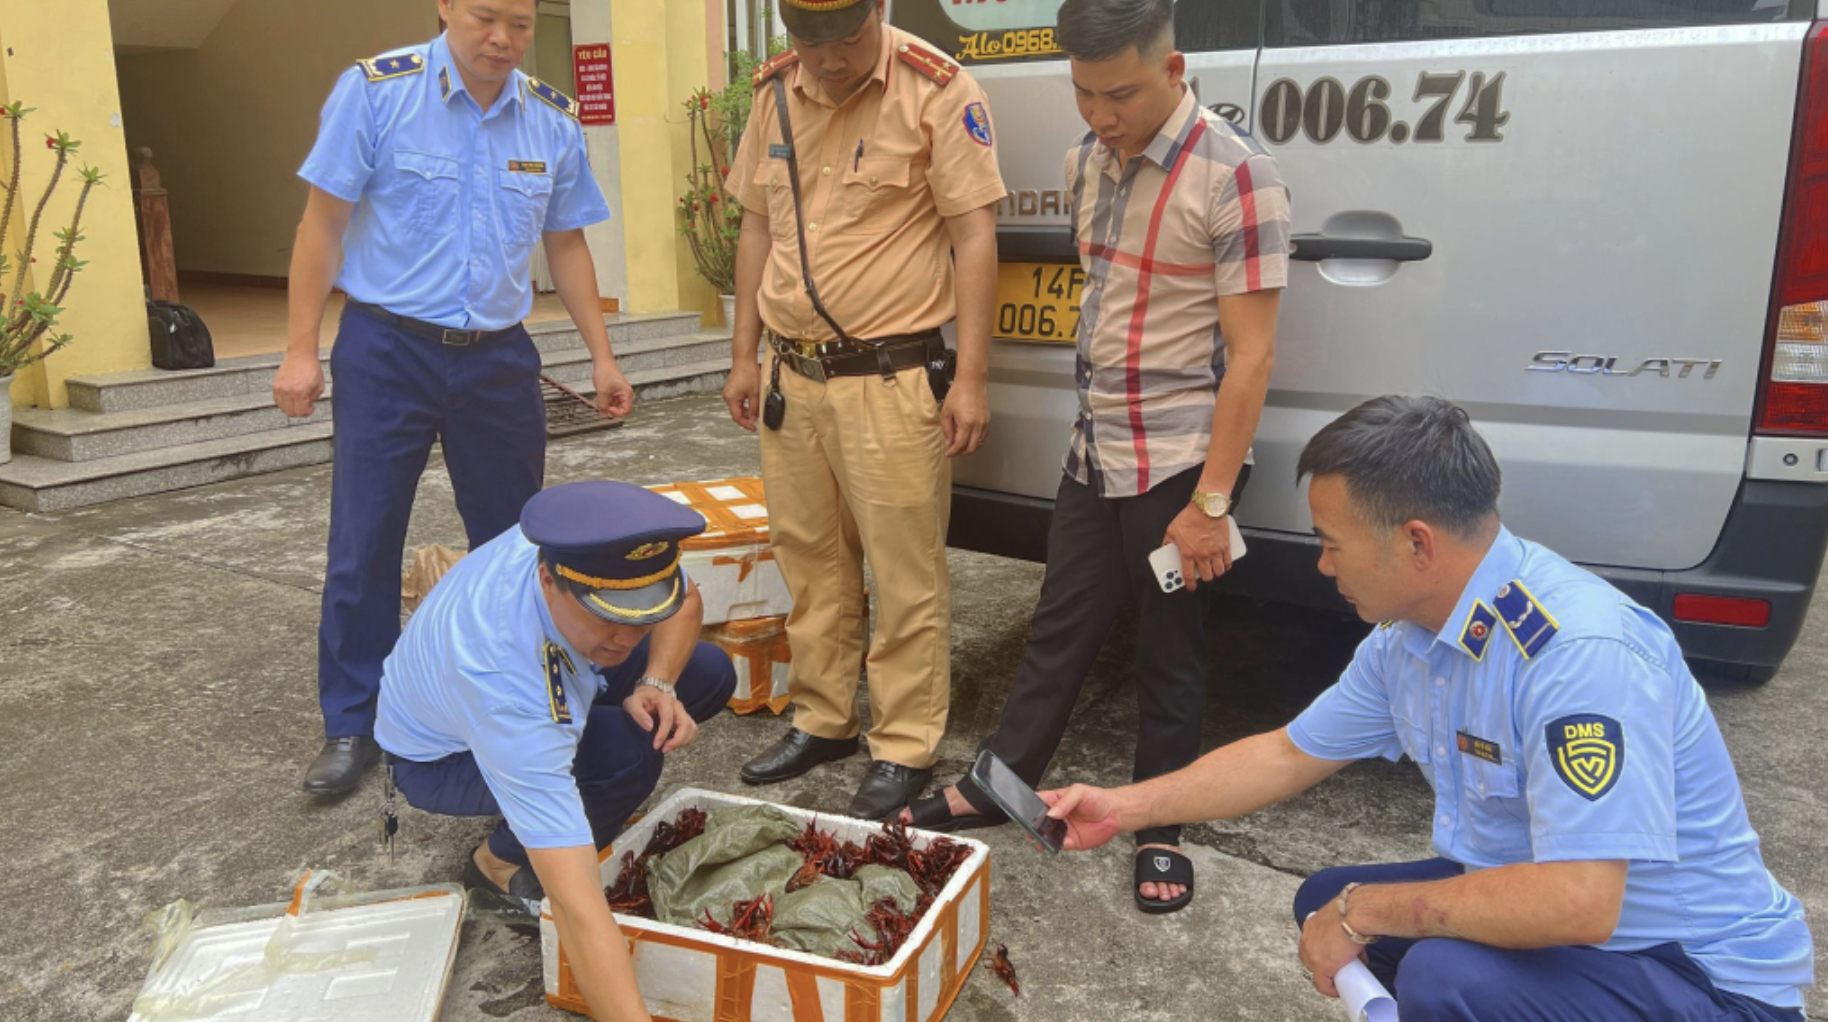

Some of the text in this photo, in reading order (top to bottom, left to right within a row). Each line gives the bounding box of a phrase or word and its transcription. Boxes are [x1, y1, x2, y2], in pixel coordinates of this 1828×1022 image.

[1002, 28, 1060, 53] 0968.
[1258, 70, 1511, 145] 006.74
[999, 303, 1082, 338] 006.7
[1525, 351, 1722, 379] SOLATI
[1564, 722, 1605, 739] DMS
